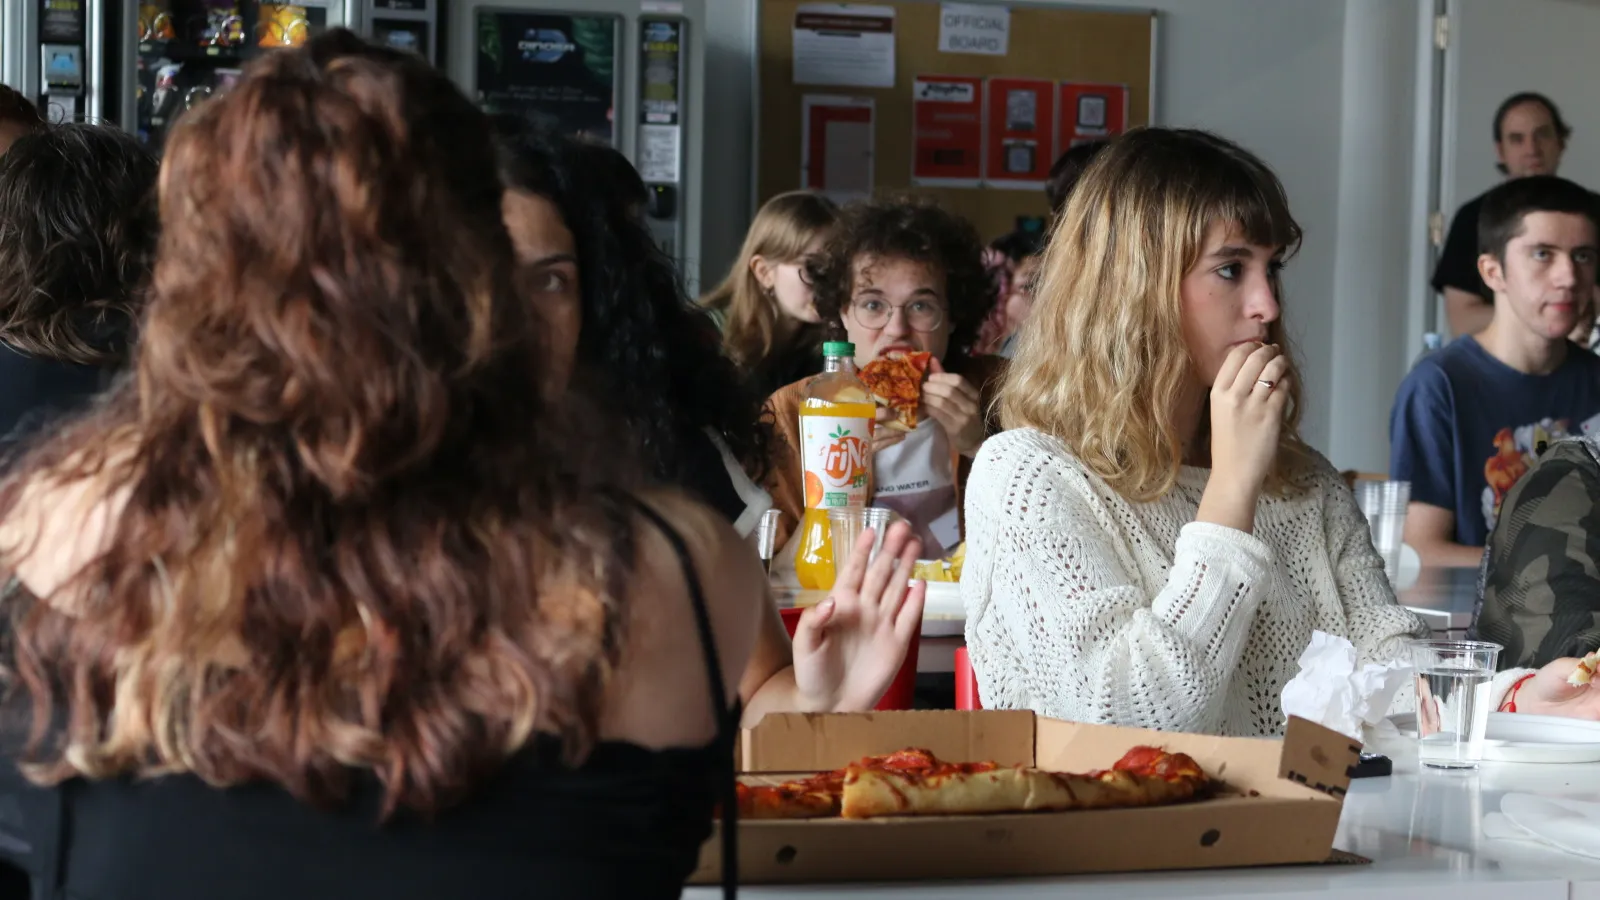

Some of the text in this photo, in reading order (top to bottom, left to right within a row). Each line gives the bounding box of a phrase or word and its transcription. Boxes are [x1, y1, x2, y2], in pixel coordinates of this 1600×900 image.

[945, 14, 1005, 31] OFFICIAL
[949, 35, 1000, 51] BOARD
[896, 479, 929, 492] WATER
